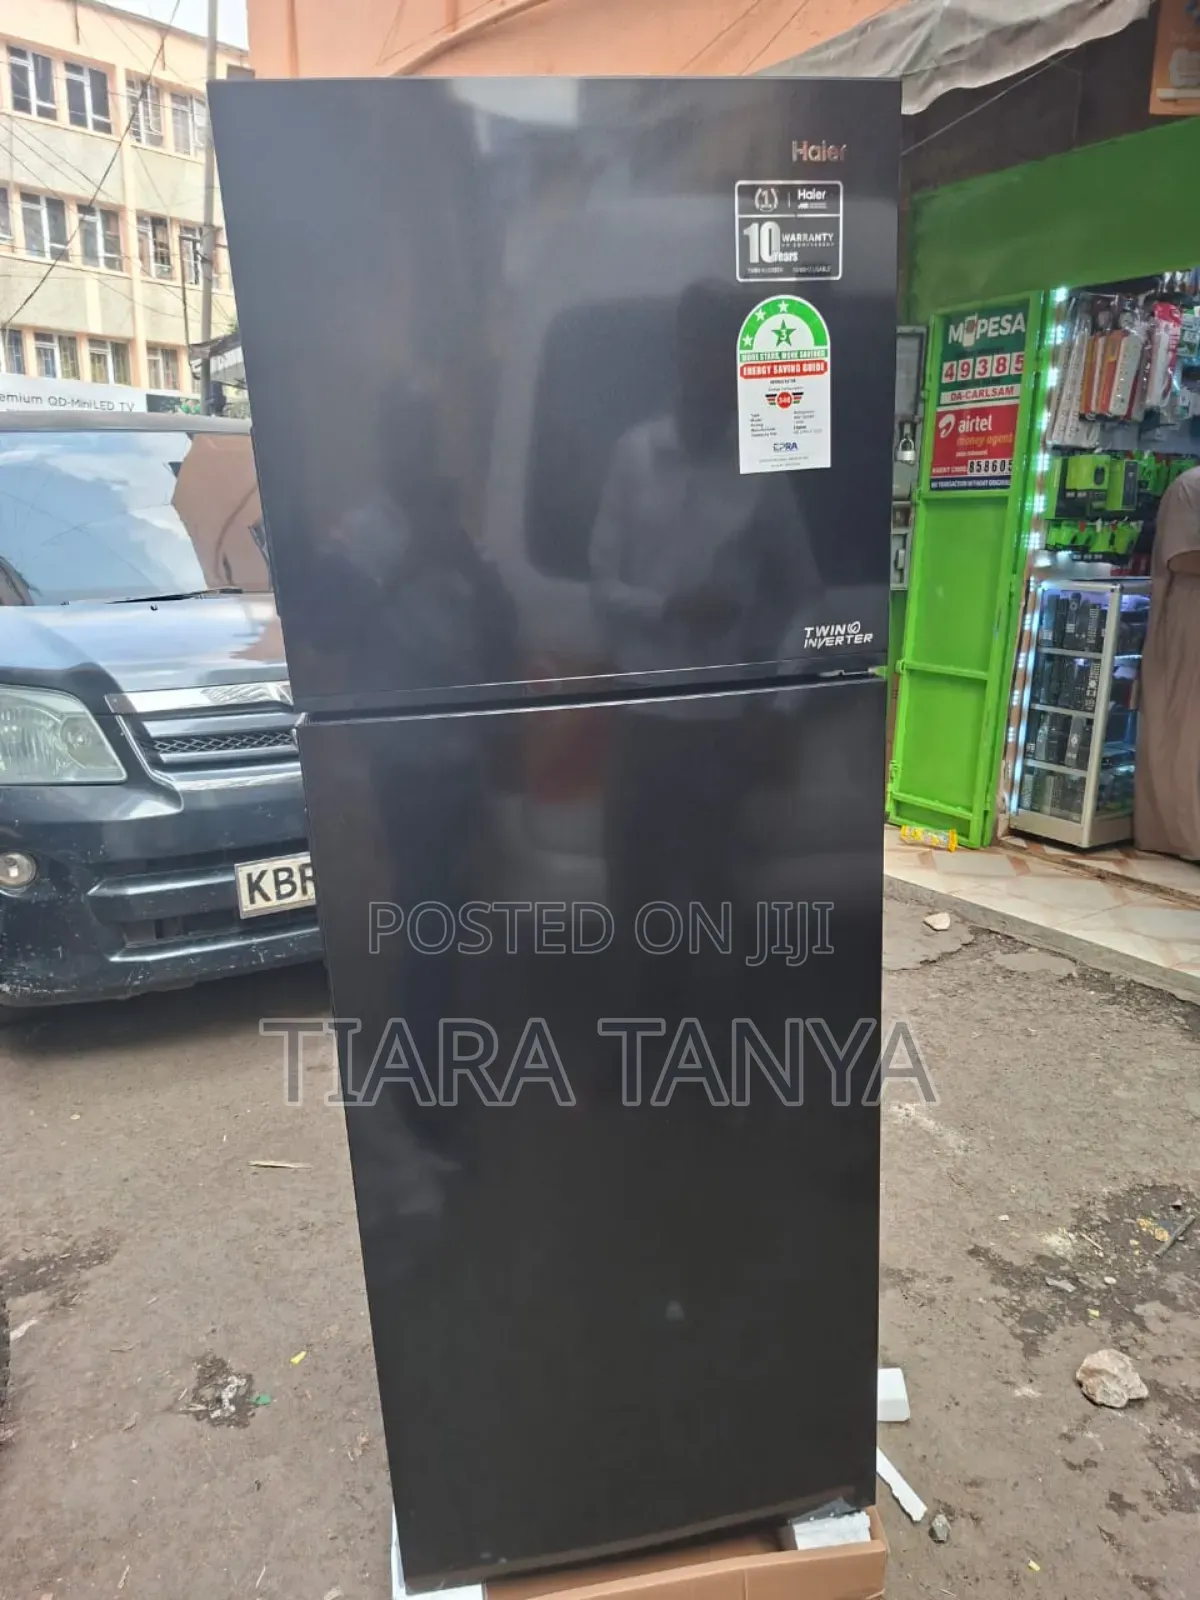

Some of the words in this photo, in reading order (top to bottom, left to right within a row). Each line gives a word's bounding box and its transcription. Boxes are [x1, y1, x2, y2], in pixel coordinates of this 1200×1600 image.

[792, 140, 847, 162] Haier
[797, 188, 826, 200] Haier
[743, 221, 780, 263] 10
[782, 233, 834, 242] WARRANTY
[743, 364, 771, 376] ENERGY
[943, 353, 1024, 380] 49385
[120, 402, 135, 412] TV
[958, 414, 992, 433] airtel
[804, 623, 847, 638] TWIN
[803, 633, 874, 649] INVERTER
